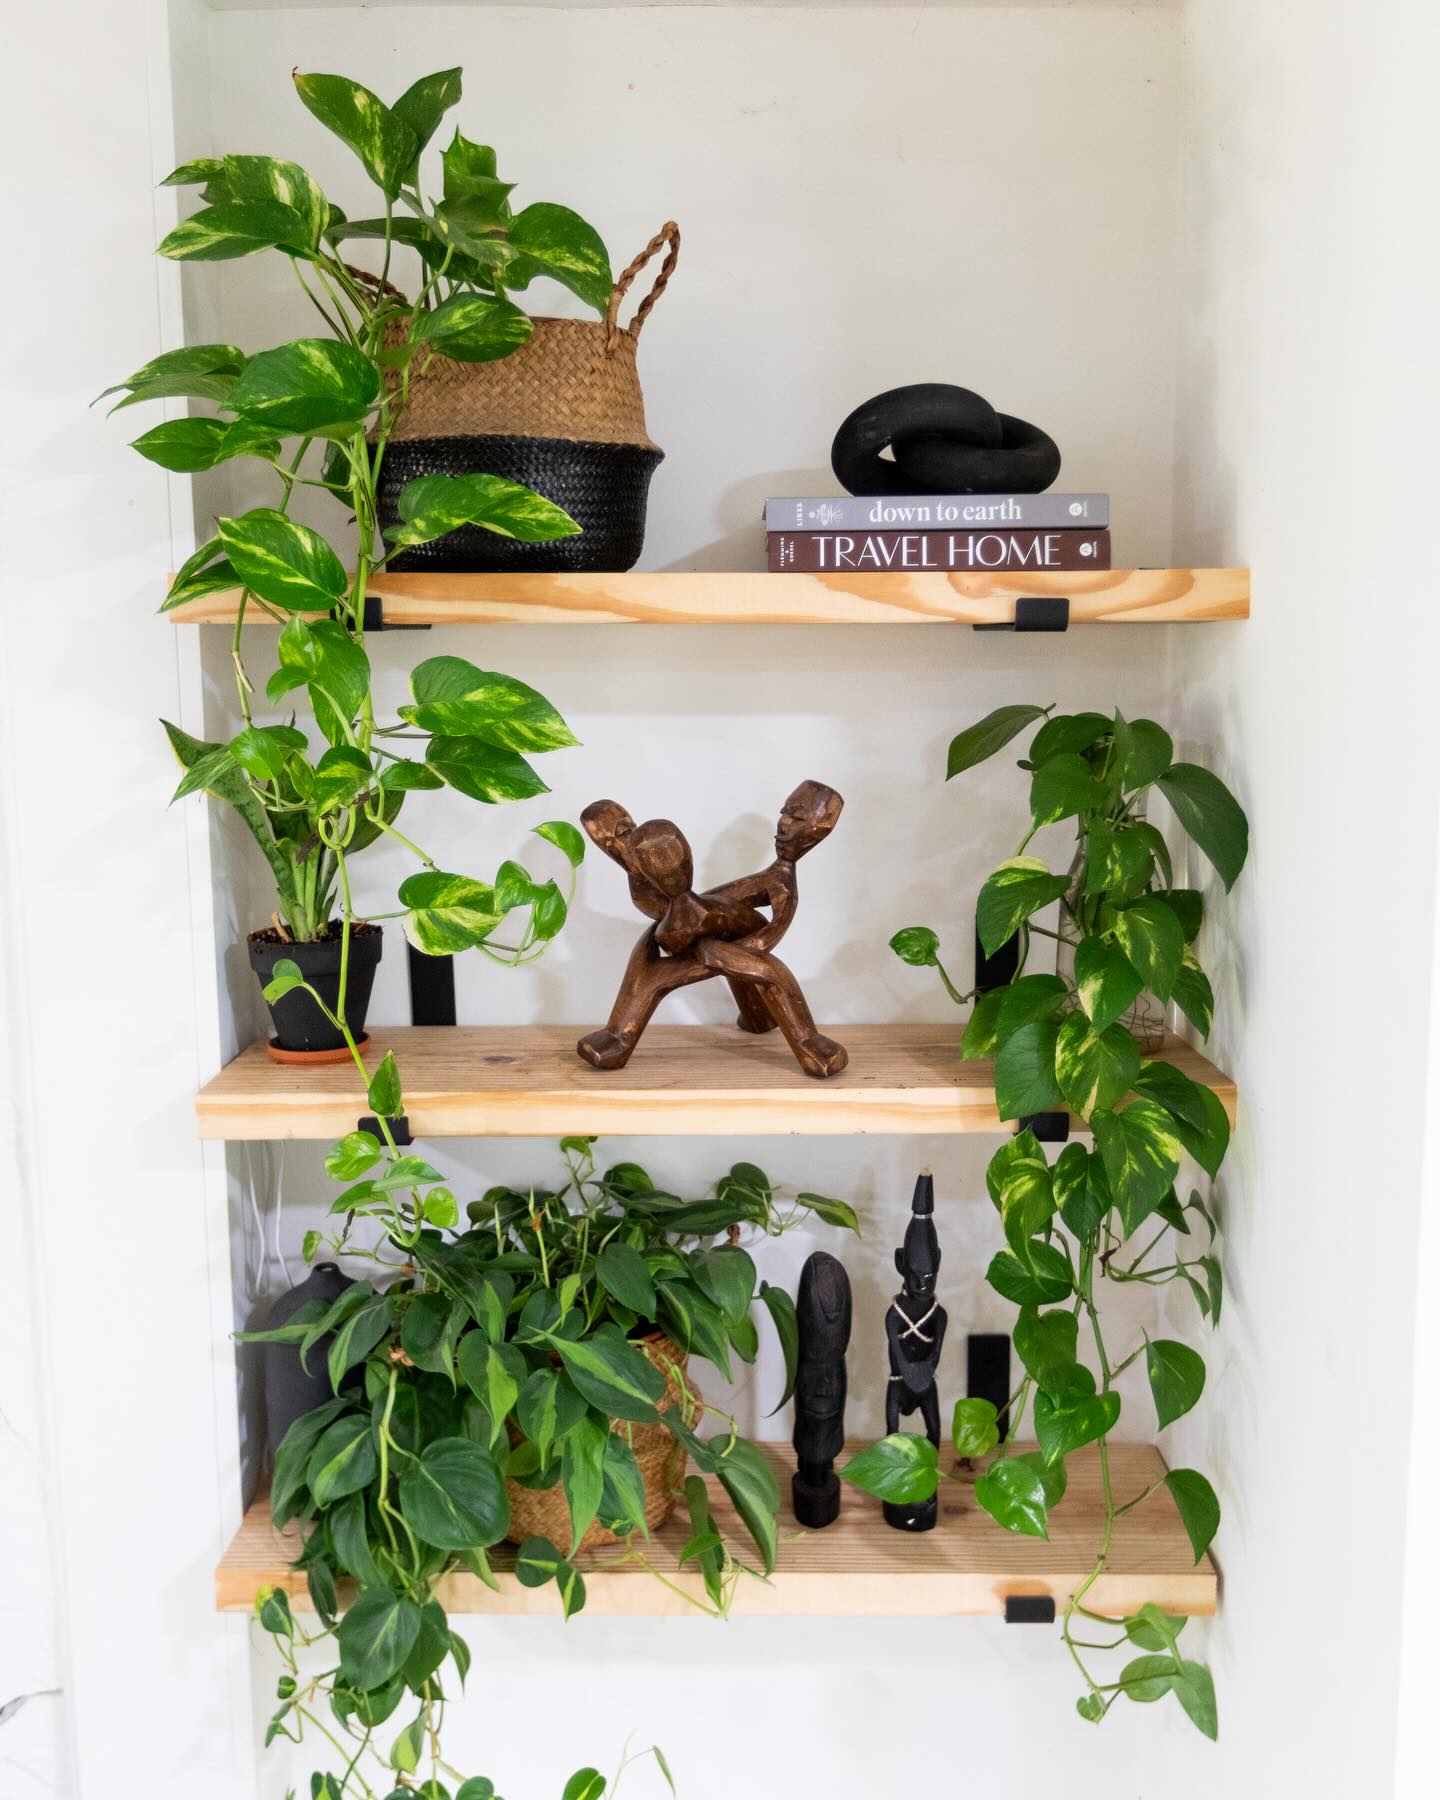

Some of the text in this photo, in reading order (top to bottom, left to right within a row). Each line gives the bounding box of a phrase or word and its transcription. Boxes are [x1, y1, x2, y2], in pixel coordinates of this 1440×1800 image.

[869, 497, 1022, 522] down to earth
[811, 535, 938, 567] TRAVEL
[948, 534, 1063, 567] HOME
